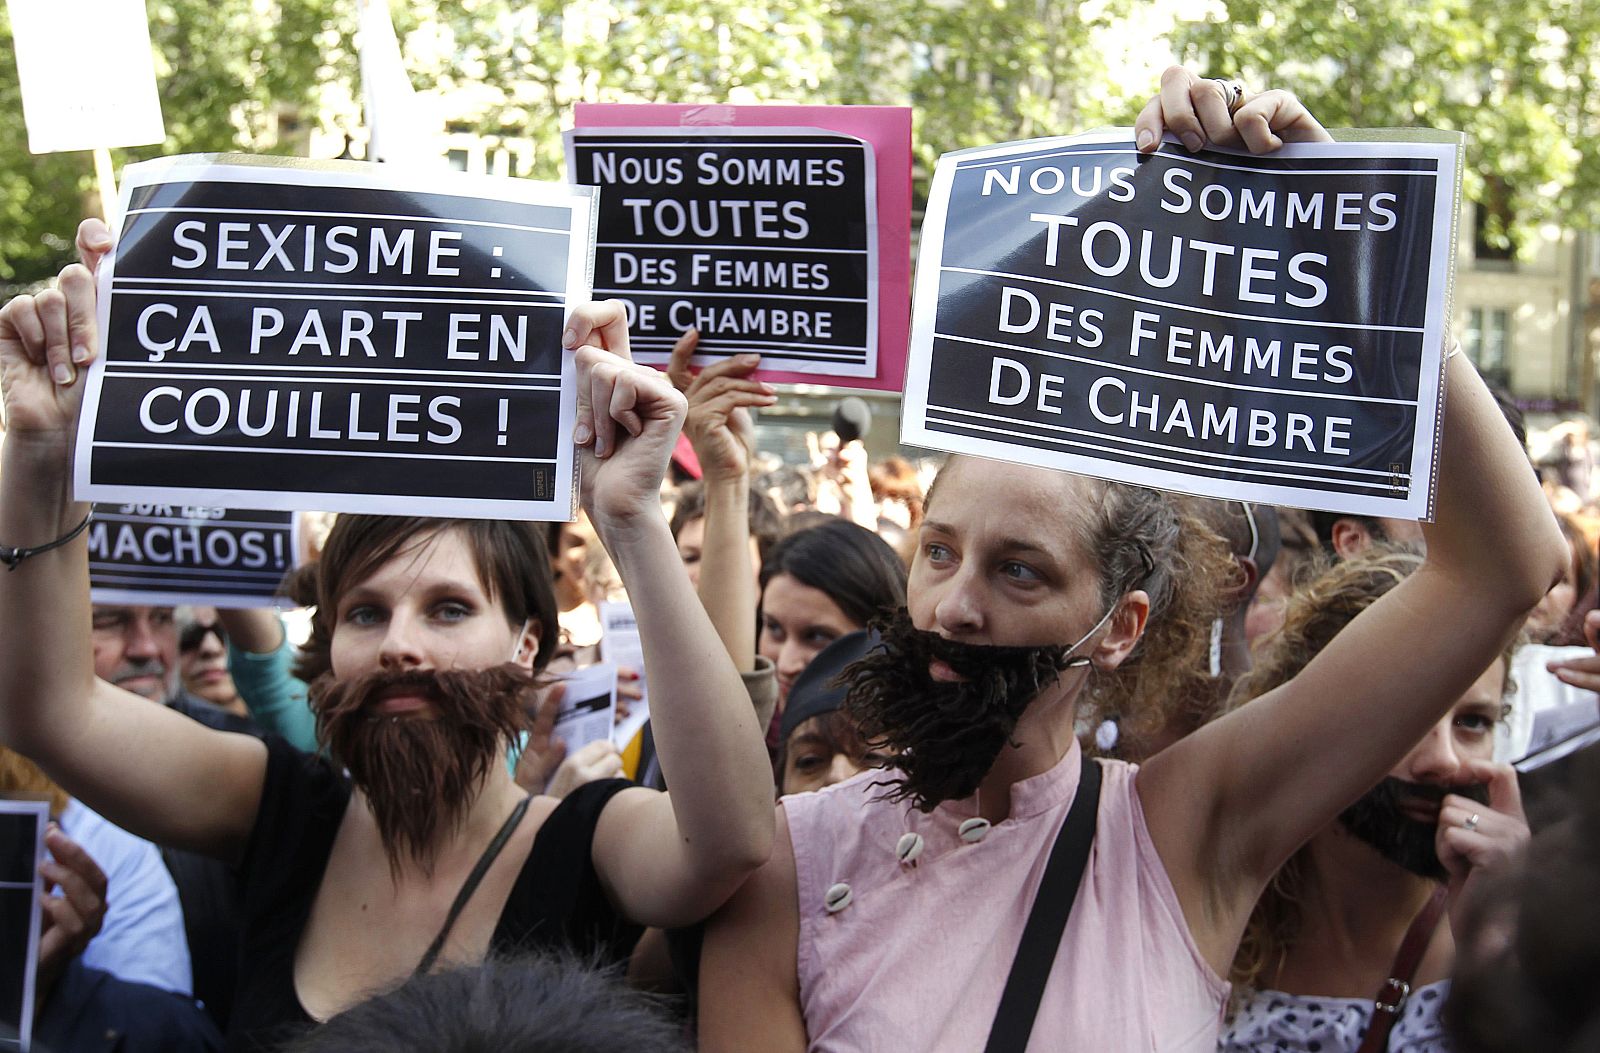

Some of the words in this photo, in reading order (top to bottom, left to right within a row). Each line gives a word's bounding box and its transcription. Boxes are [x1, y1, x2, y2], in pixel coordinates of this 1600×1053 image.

[592, 152, 683, 185] NOUS
[697, 152, 845, 187] SOMMES
[622, 198, 809, 240] TOUTES
[981, 165, 1136, 202] NOUS
[1160, 167, 1397, 232] SOMMES
[171, 220, 463, 276] SEXISME
[613, 252, 677, 286] DES
[691, 254, 830, 291] FEMMES
[1030, 212, 1328, 308] TOUTES
[136, 303, 222, 362] ÇA
[250, 307, 423, 358] PART
[447, 313, 529, 362] EN
[669, 300, 833, 339] CHAMBRE
[998, 286, 1104, 348] DES
[1129, 310, 1354, 384] FEMMES
[139, 386, 462, 445] COUILLES
[497, 398, 509, 446] !
[988, 356, 1065, 415] DE
[1088, 376, 1353, 457] CHAMBRE
[88, 522, 285, 569] MACHOS!
